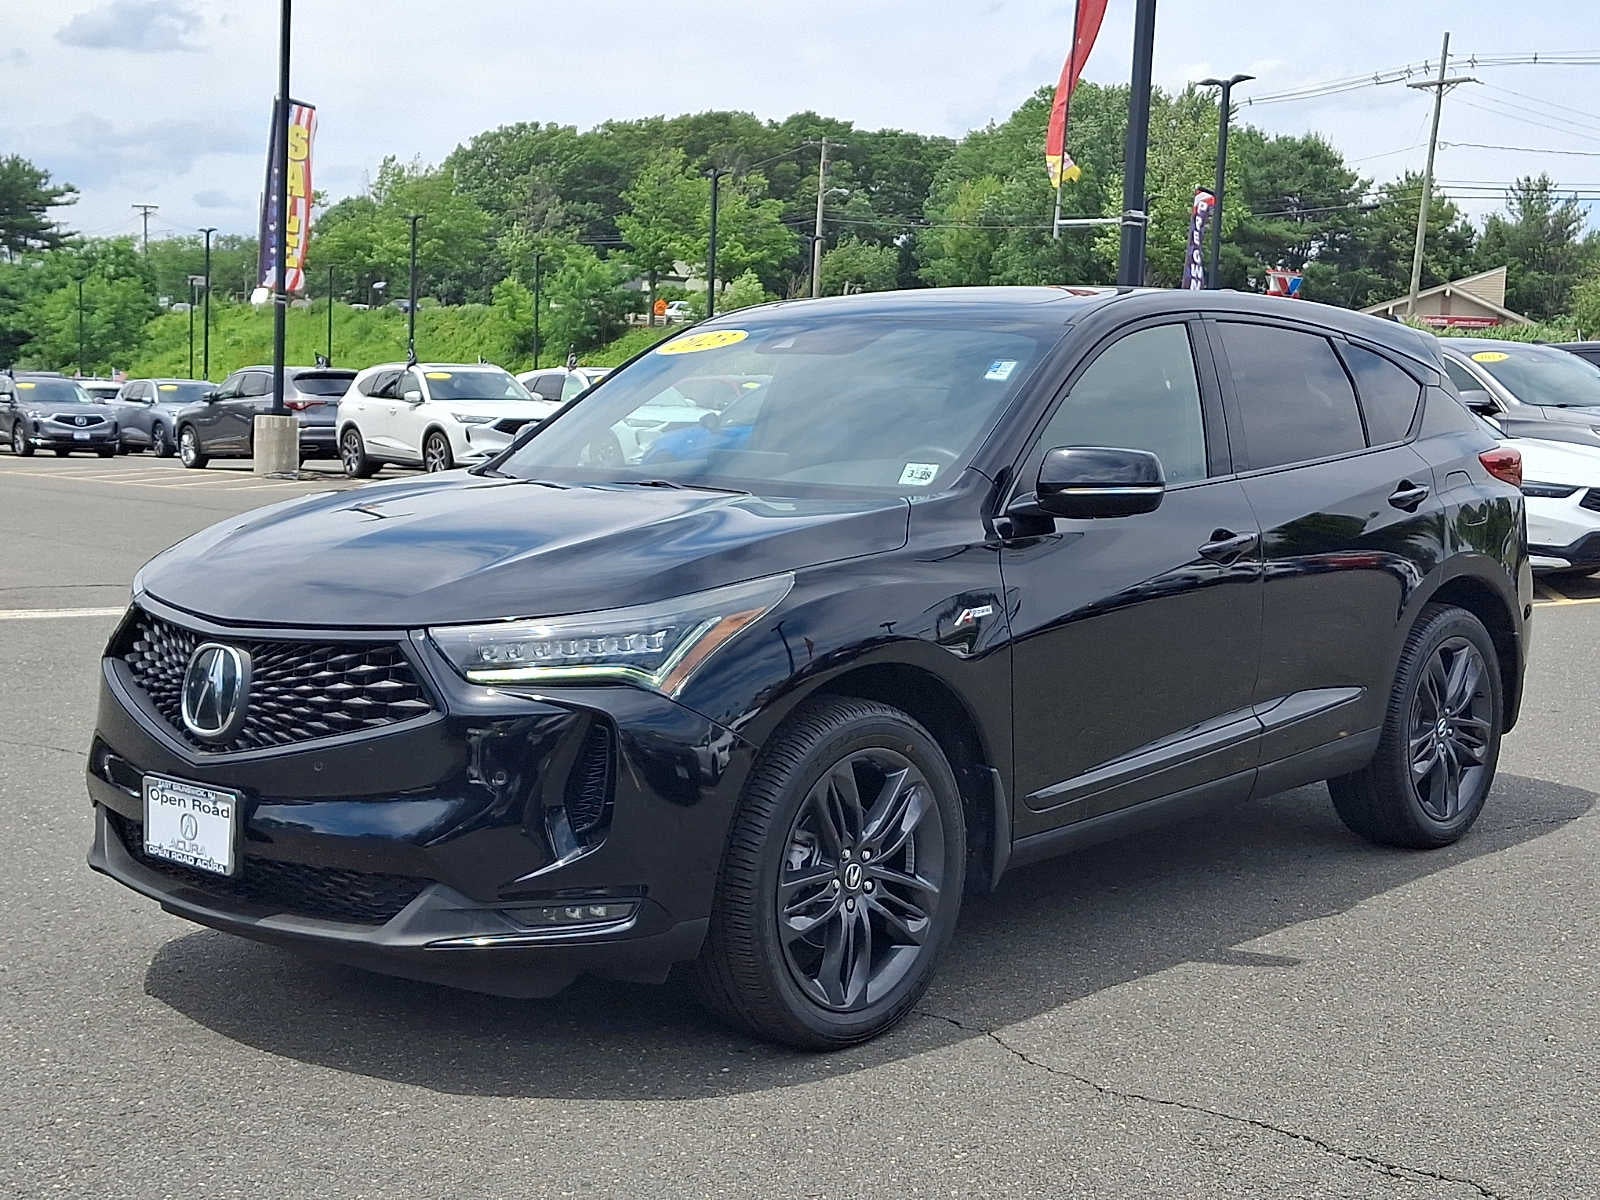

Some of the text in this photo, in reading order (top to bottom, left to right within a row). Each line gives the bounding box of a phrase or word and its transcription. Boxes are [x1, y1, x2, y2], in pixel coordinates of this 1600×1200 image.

[150, 788, 230, 819] Open Road
[148, 845, 226, 874] OPEN ROAD ACURA
